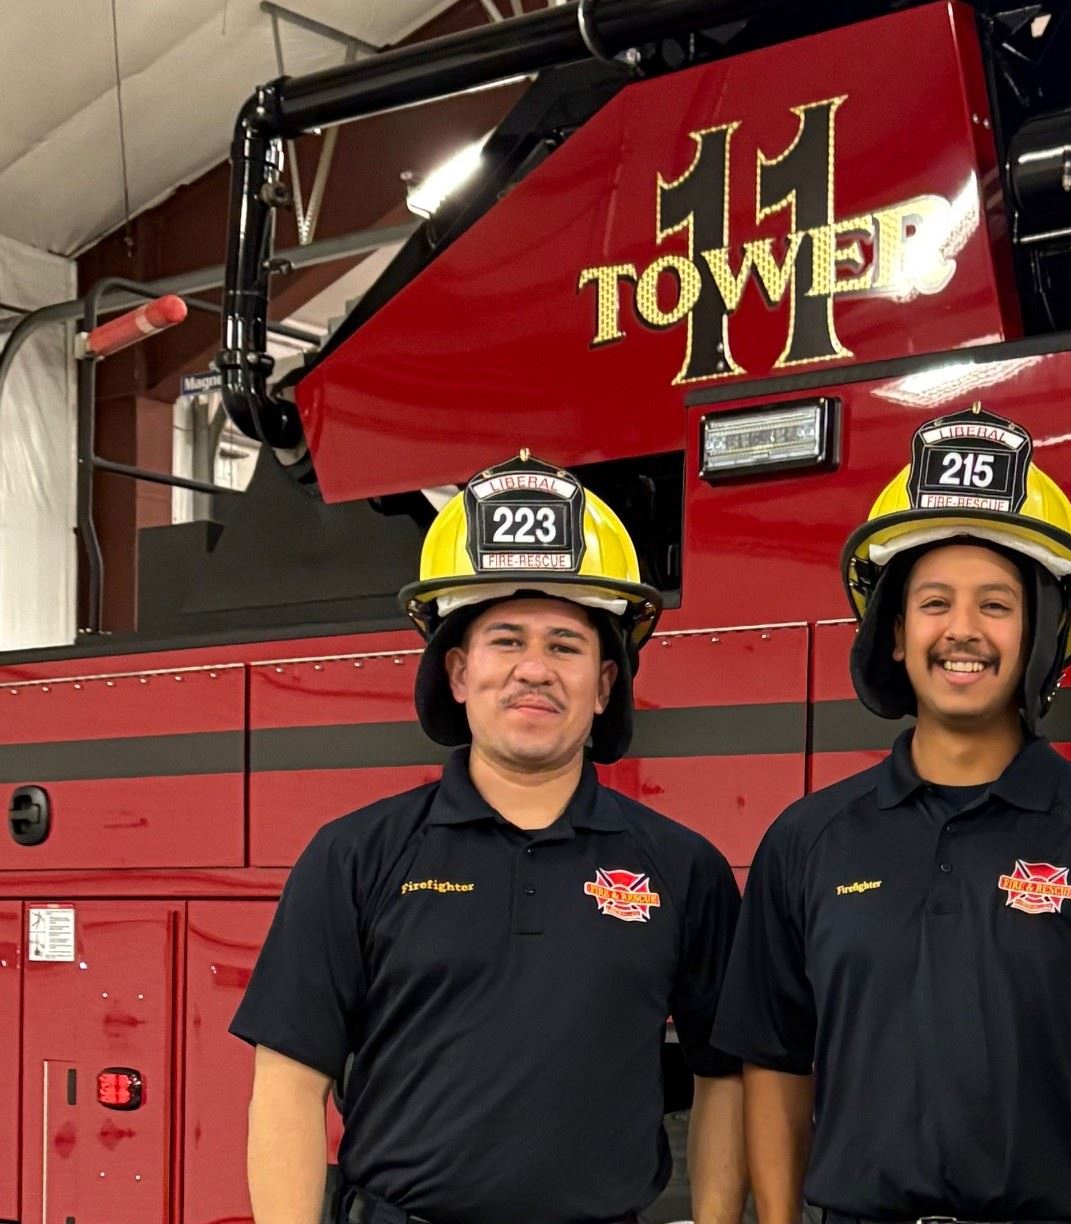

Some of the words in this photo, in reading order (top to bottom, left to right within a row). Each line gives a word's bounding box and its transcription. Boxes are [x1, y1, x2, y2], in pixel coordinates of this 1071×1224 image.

[656, 95, 854, 385] 11
[578, 194, 956, 347] TOWER
[940, 426, 1006, 443] LIBERAL
[939, 452, 995, 488] 215
[490, 475, 558, 492] LIBERAL
[927, 495, 1005, 511] FIRE-RESCUE
[492, 506, 557, 543] 223
[488, 554, 566, 567] FIRE-RESCUE
[401, 879, 475, 894] Firefighter
[836, 880, 882, 896] Firefighter
[1003, 878, 1026, 892] FIRE
[621, 892, 657, 904] RESCUE
